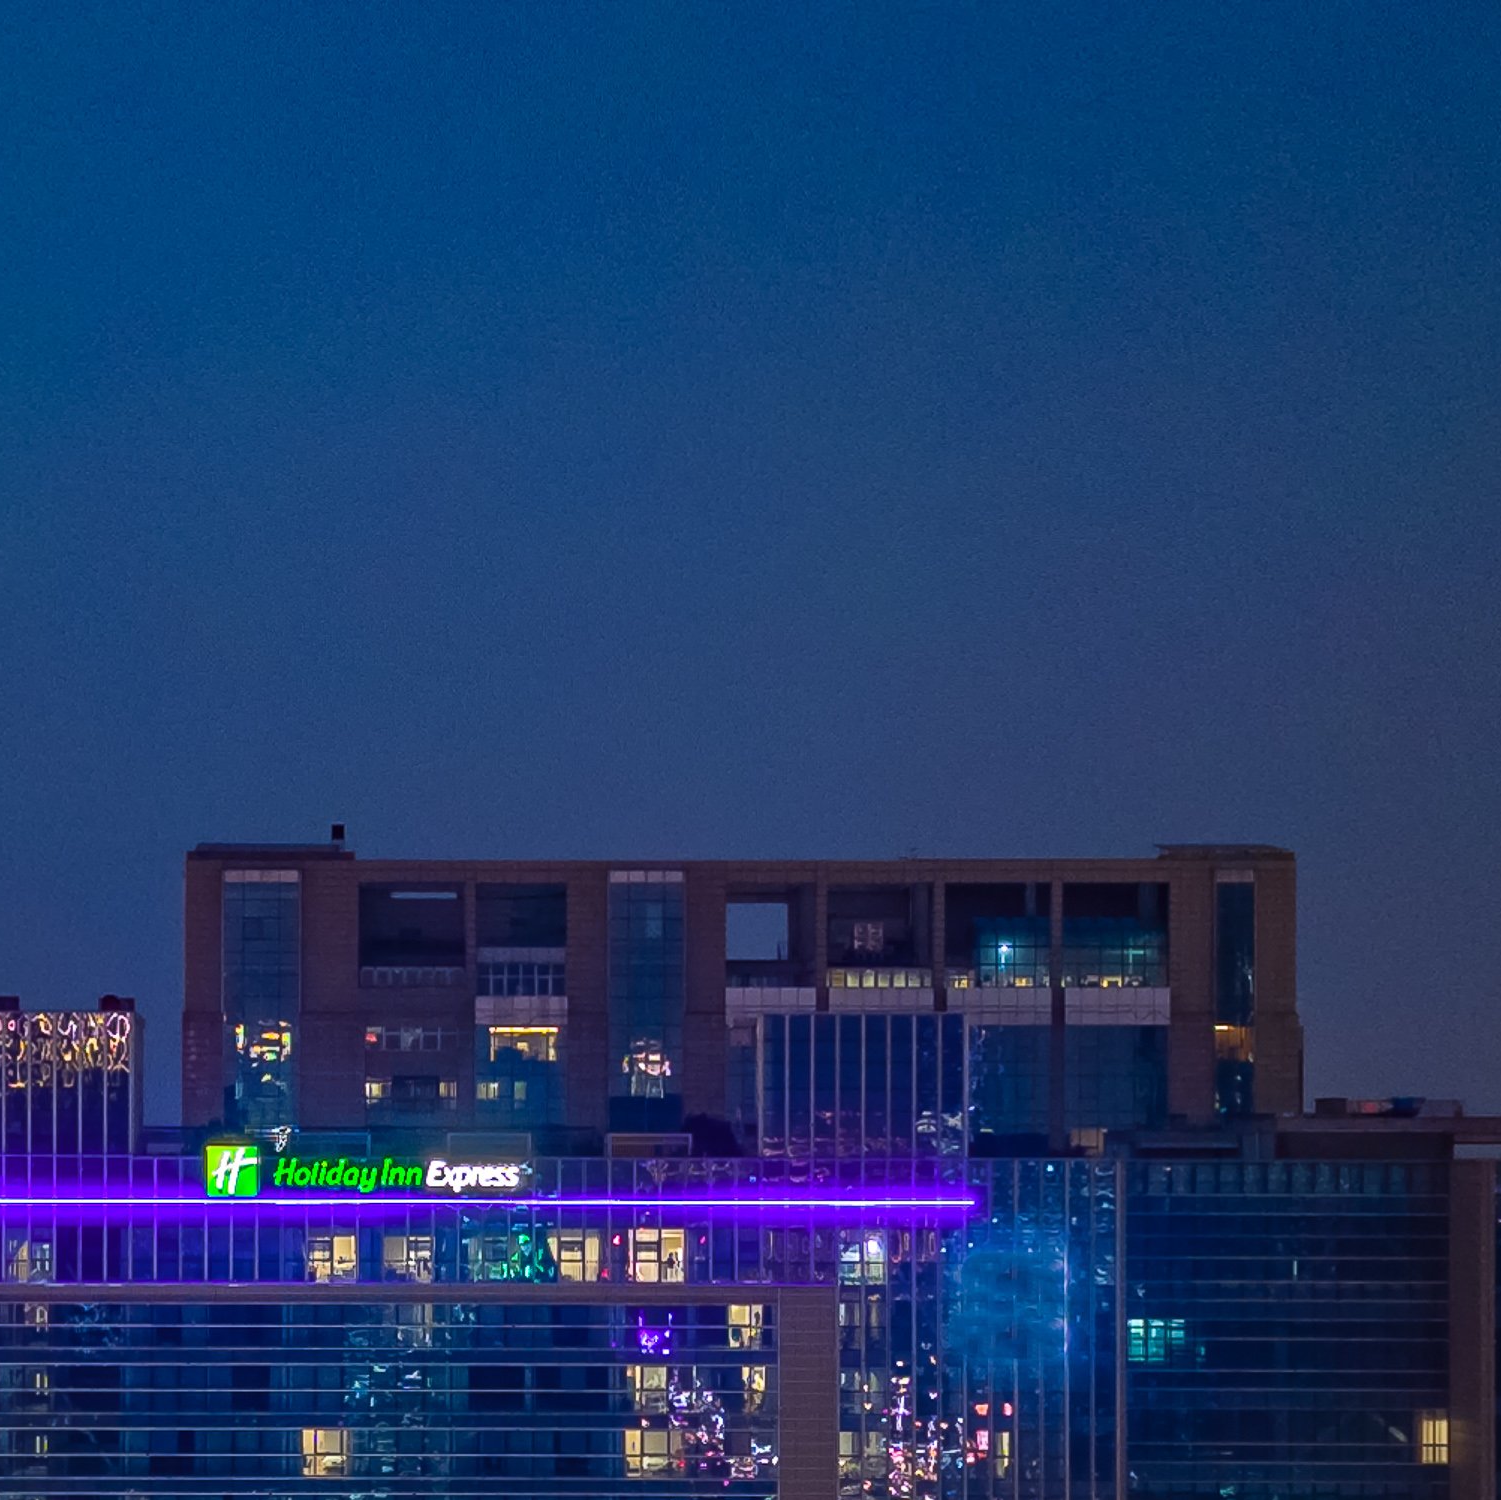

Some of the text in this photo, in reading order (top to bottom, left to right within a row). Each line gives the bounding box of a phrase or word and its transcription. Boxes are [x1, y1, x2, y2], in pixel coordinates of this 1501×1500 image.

[273, 1158, 378, 1193] Holiday
[380, 1157, 423, 1186] Inn
[425, 1160, 520, 1193] Express
